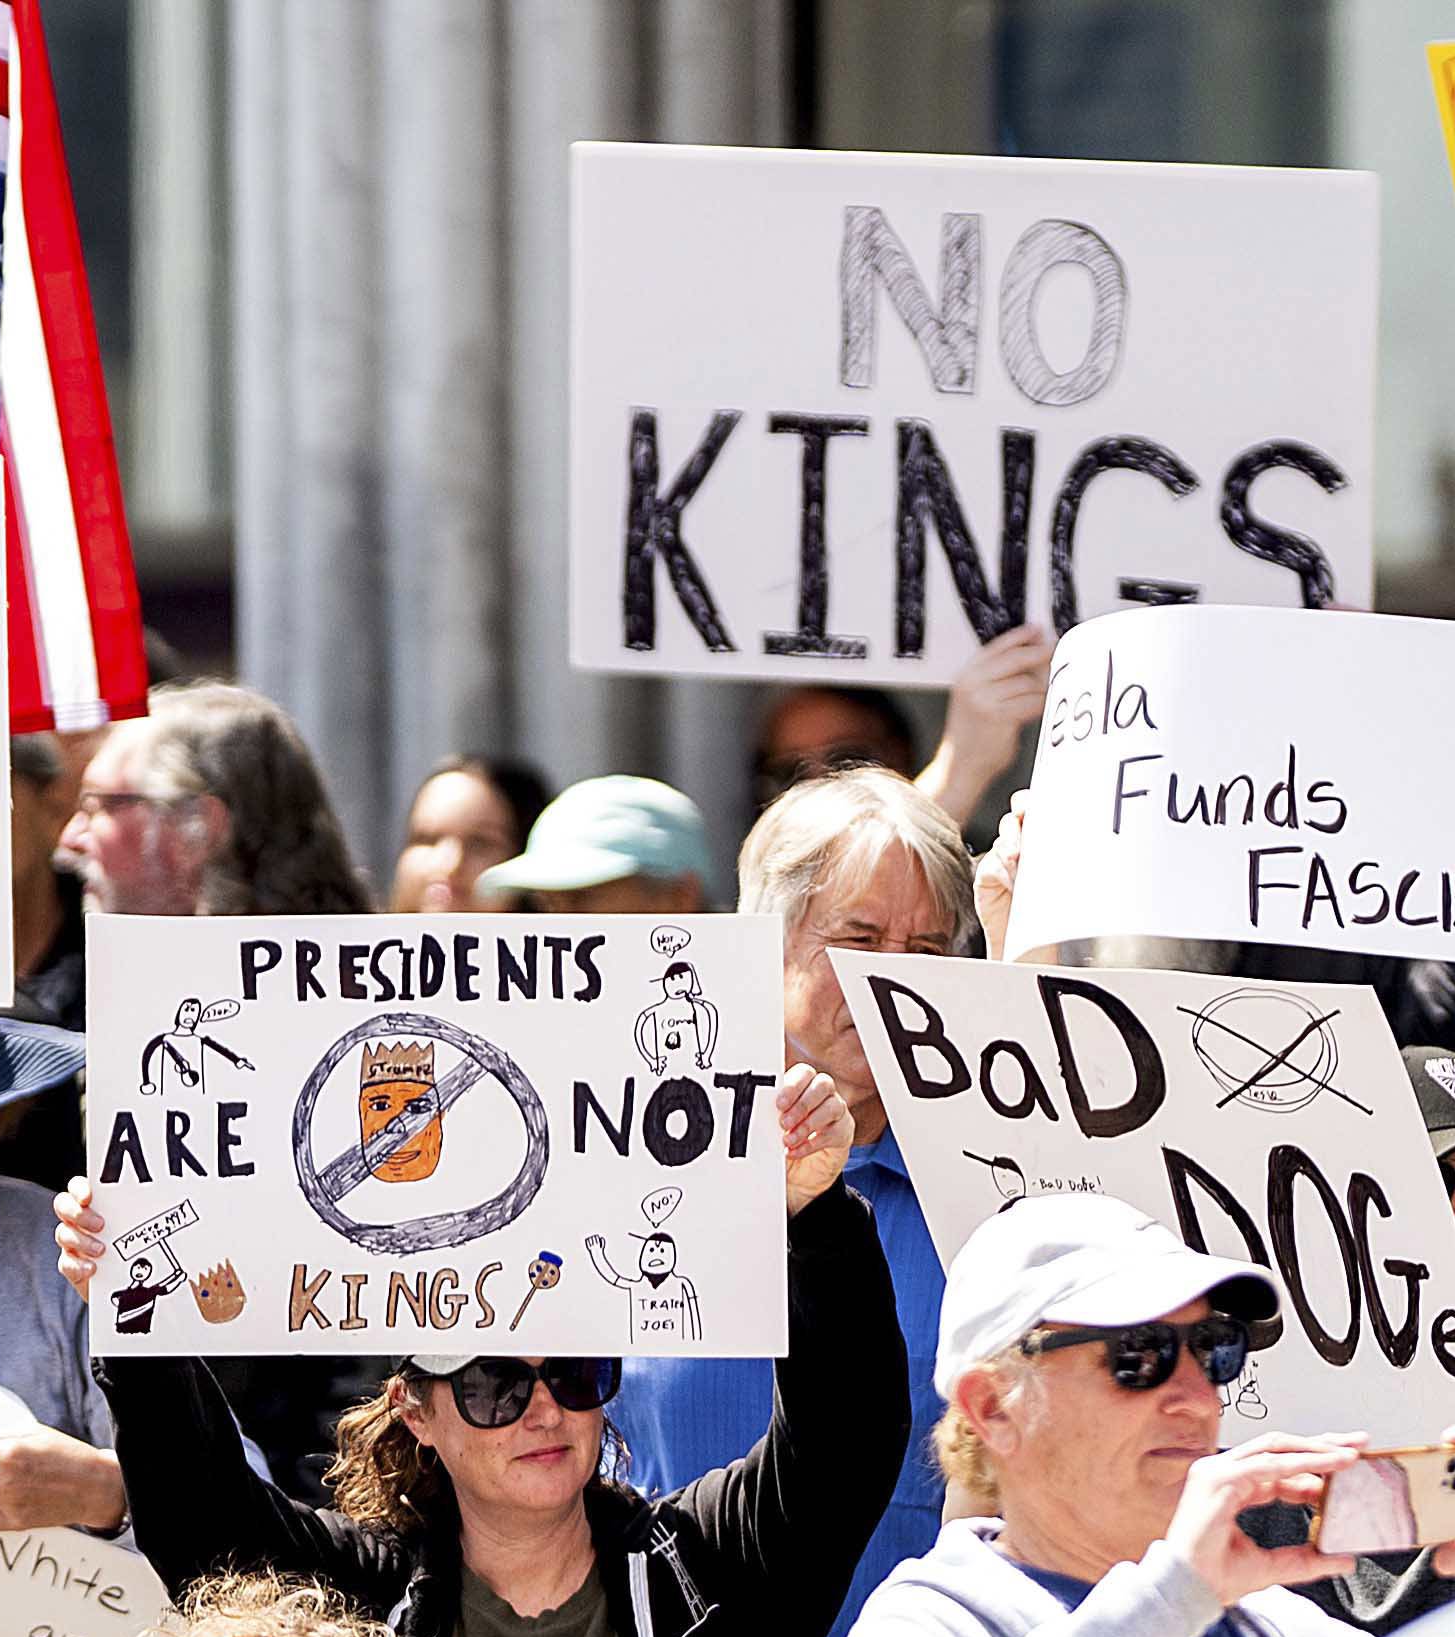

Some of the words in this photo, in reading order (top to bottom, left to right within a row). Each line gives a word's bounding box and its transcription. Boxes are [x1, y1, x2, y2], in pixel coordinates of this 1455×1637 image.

[837, 204, 1130, 407] NO
[621, 405, 1350, 660] KINGS
[1111, 744, 1349, 836] Funds
[240, 932, 607, 1004] PRESIDENTS
[99, 1101, 257, 1186] ARE
[573, 1070, 777, 1168] NOT
[287, 1260, 504, 1334] KINGS
